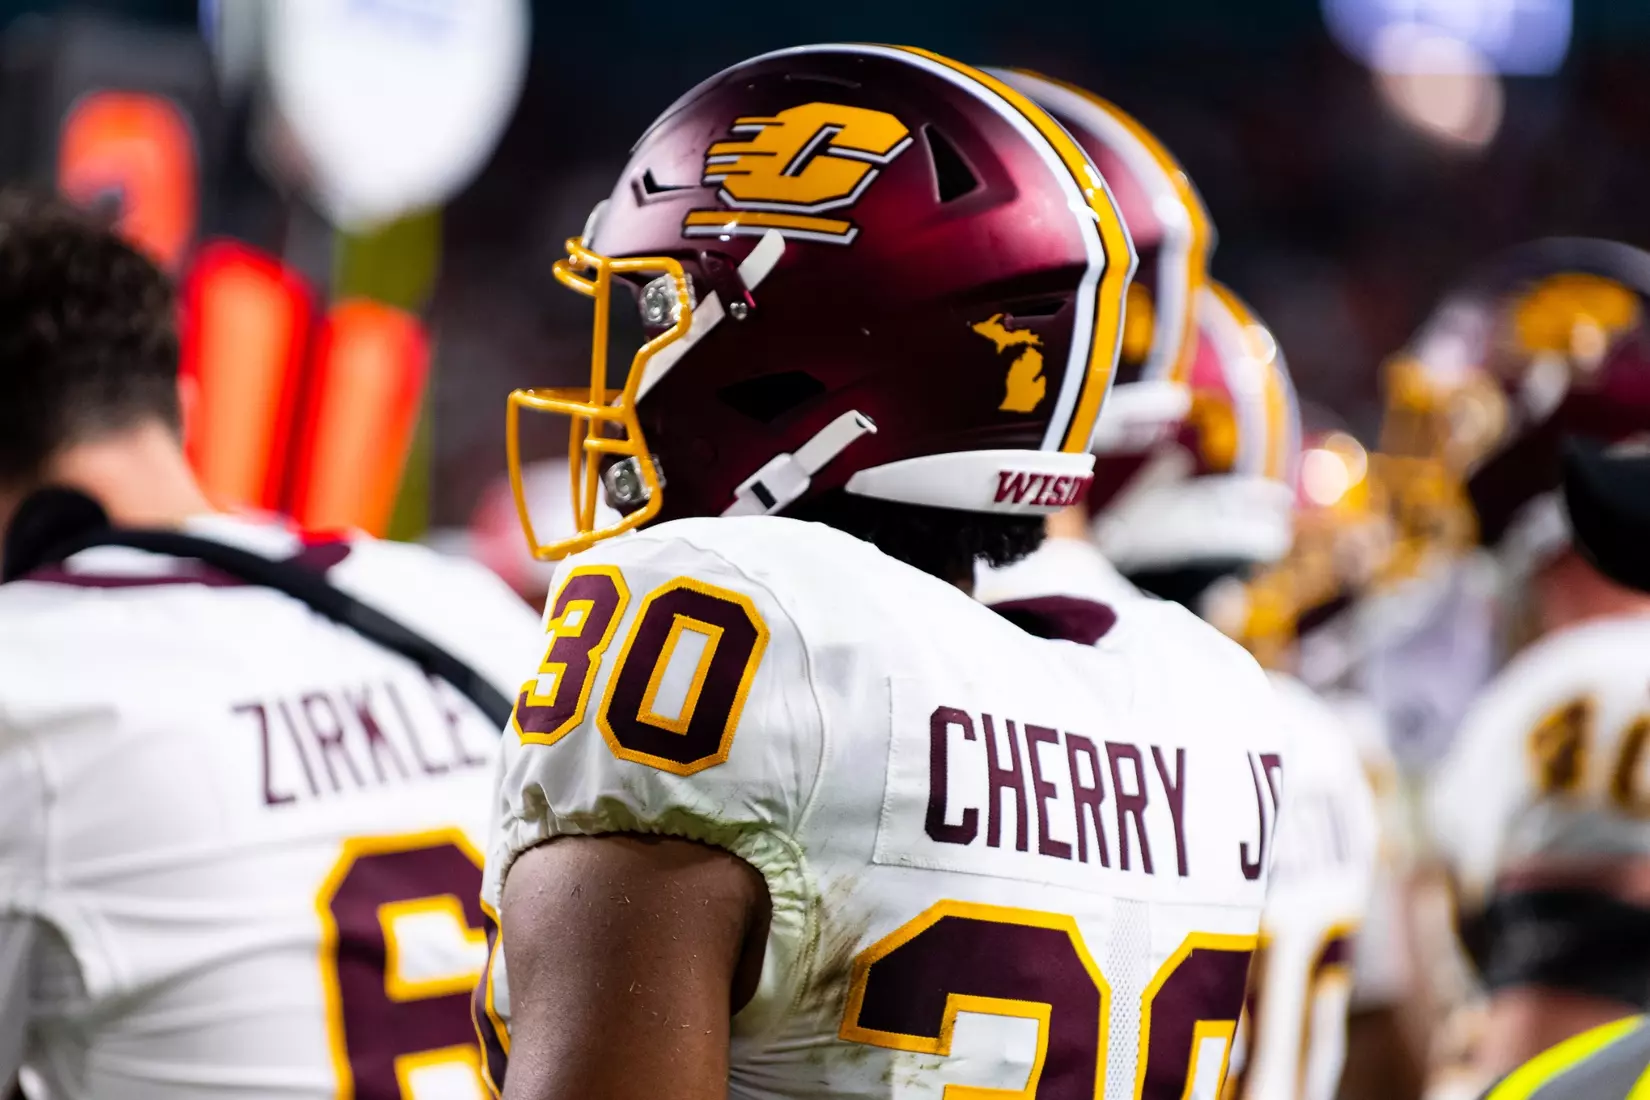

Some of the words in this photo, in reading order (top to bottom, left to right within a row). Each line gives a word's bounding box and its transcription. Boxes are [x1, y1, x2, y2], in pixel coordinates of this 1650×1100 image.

[231, 675, 489, 806] ZIRKLE
[511, 564, 772, 778] 30
[924, 705, 1190, 878] CHERRY
